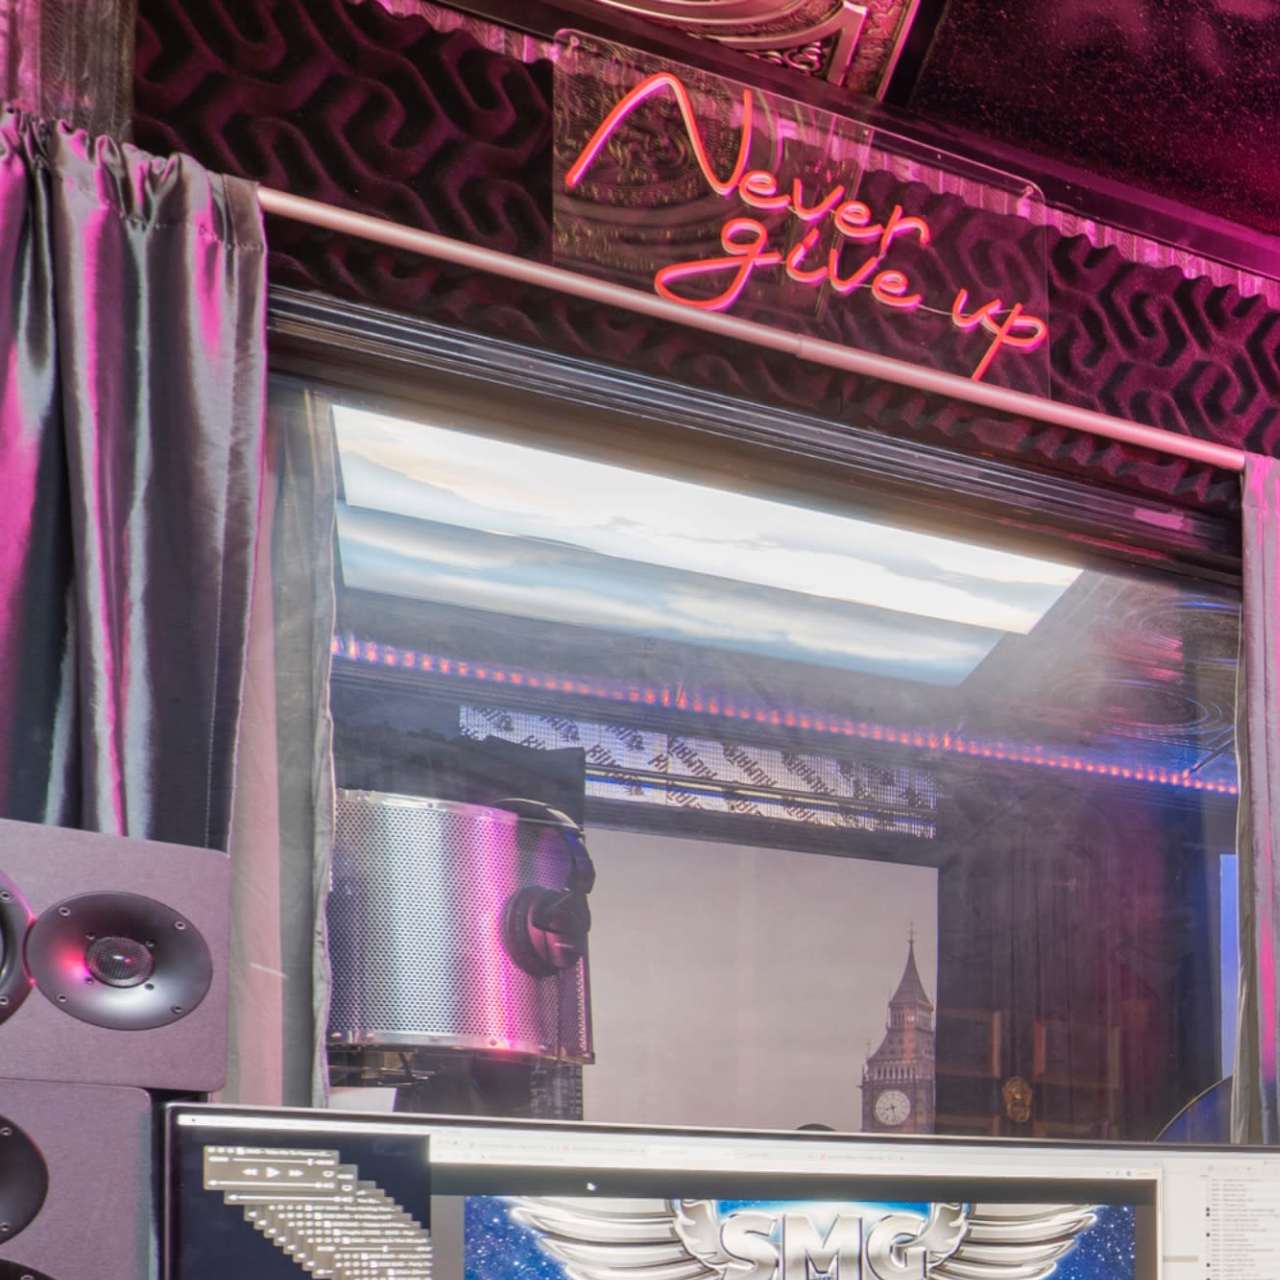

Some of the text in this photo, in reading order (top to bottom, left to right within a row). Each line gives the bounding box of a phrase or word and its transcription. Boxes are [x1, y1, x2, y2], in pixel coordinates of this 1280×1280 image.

[566, 72, 932, 247] Never
[654, 217, 1048, 381] give up
